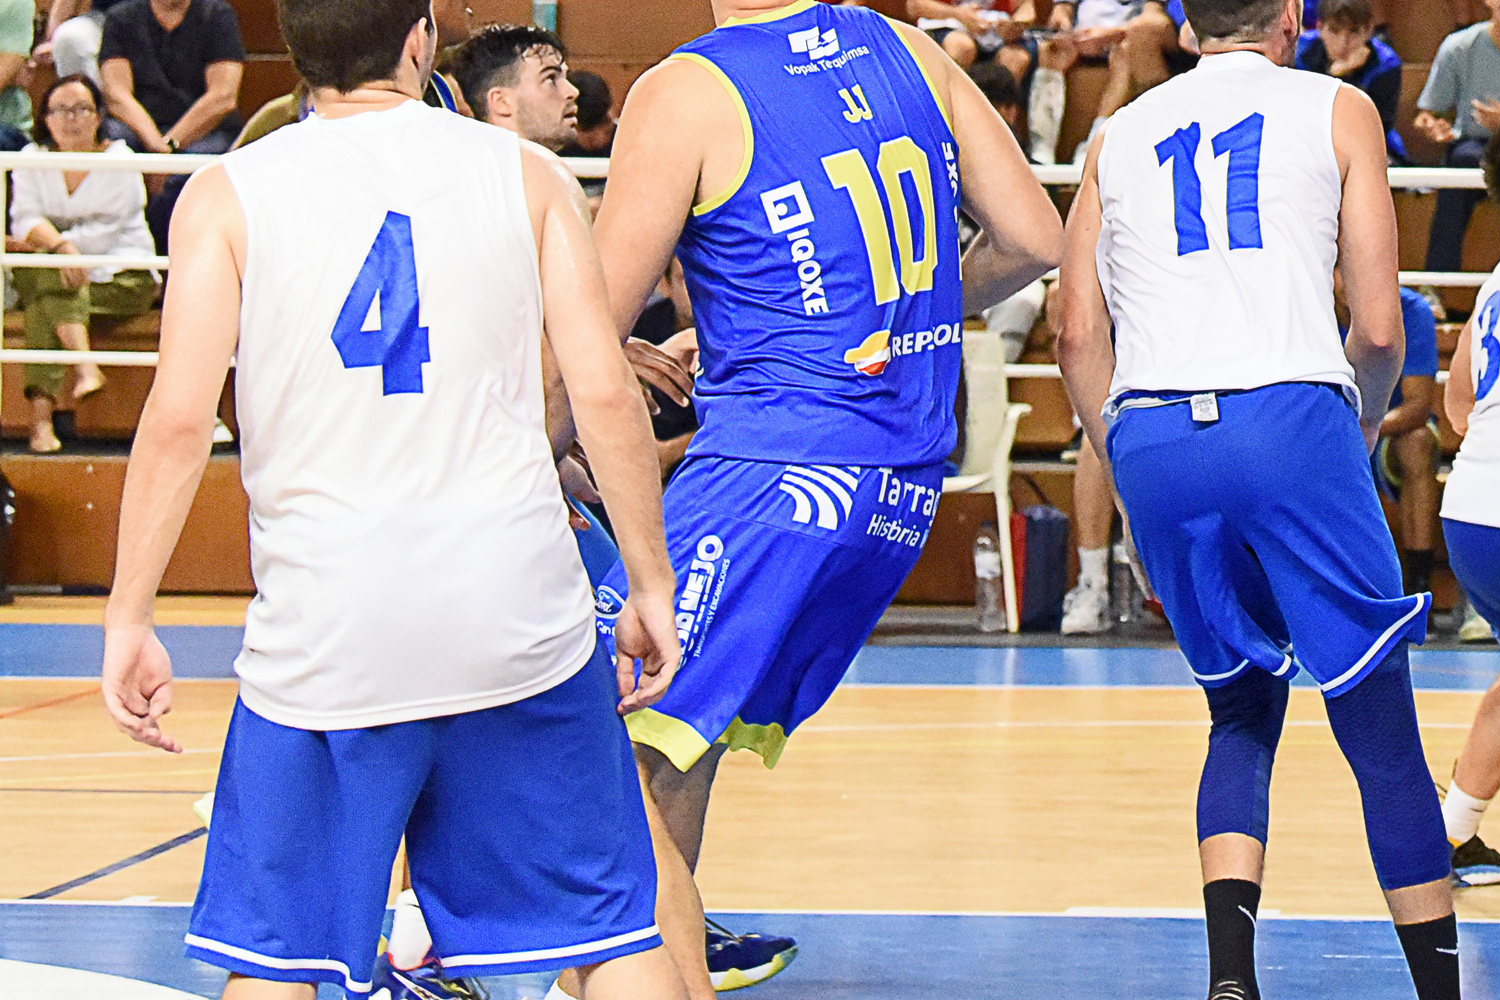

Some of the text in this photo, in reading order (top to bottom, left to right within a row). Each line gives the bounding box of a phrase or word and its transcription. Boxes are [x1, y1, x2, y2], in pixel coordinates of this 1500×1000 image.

[783, 62, 821, 76] Vopak
[838, 83, 874, 124] JJ
[820, 135, 939, 306] 10
[1154, 111, 1265, 257] 11
[331, 209, 431, 397] 4
[786, 227, 830, 316] IQOXE
[675, 534, 724, 670] ORNEJO
